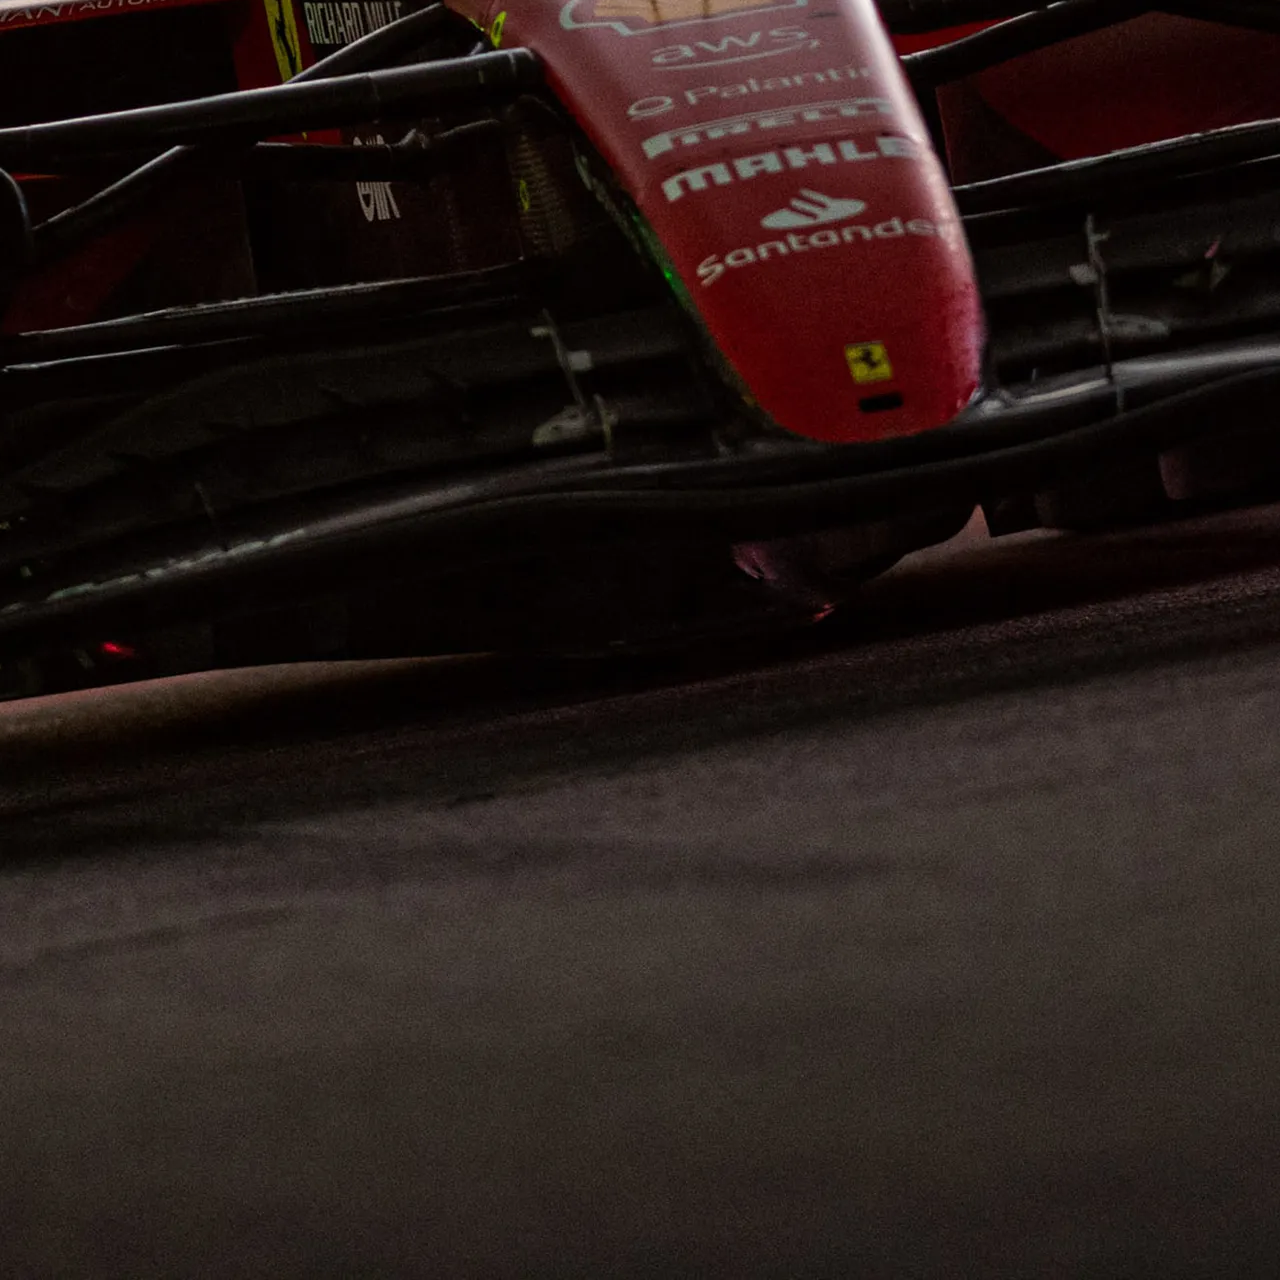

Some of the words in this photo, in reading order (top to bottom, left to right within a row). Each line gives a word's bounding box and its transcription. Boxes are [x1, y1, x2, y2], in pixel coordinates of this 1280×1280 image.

[303, 1, 365, 45] RICHARD
[651, 26, 811, 68] aws
[660, 135, 920, 203] MAHLE
